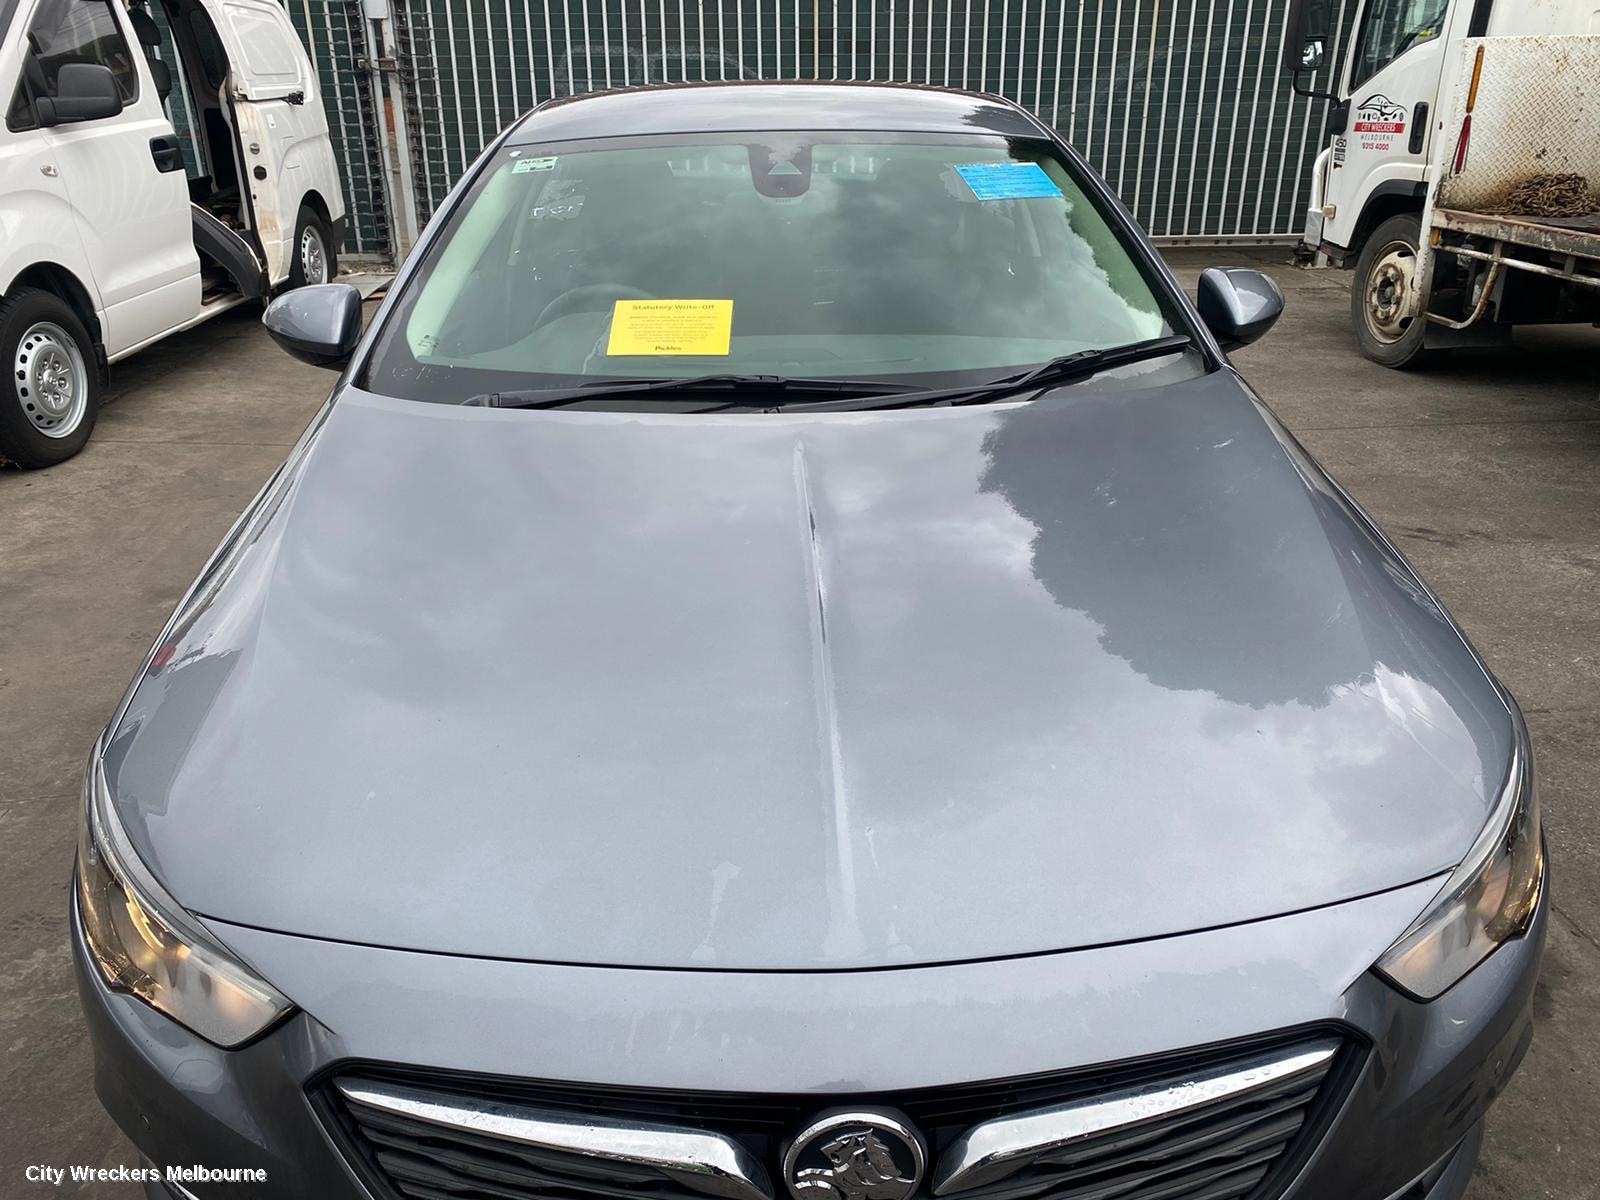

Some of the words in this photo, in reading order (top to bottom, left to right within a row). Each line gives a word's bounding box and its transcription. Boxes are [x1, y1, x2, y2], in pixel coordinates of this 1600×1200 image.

[1361, 123, 1371, 131] CITY
[1371, 123, 1396, 132] WRECKERS
[1375, 143, 1389, 151] 4000
